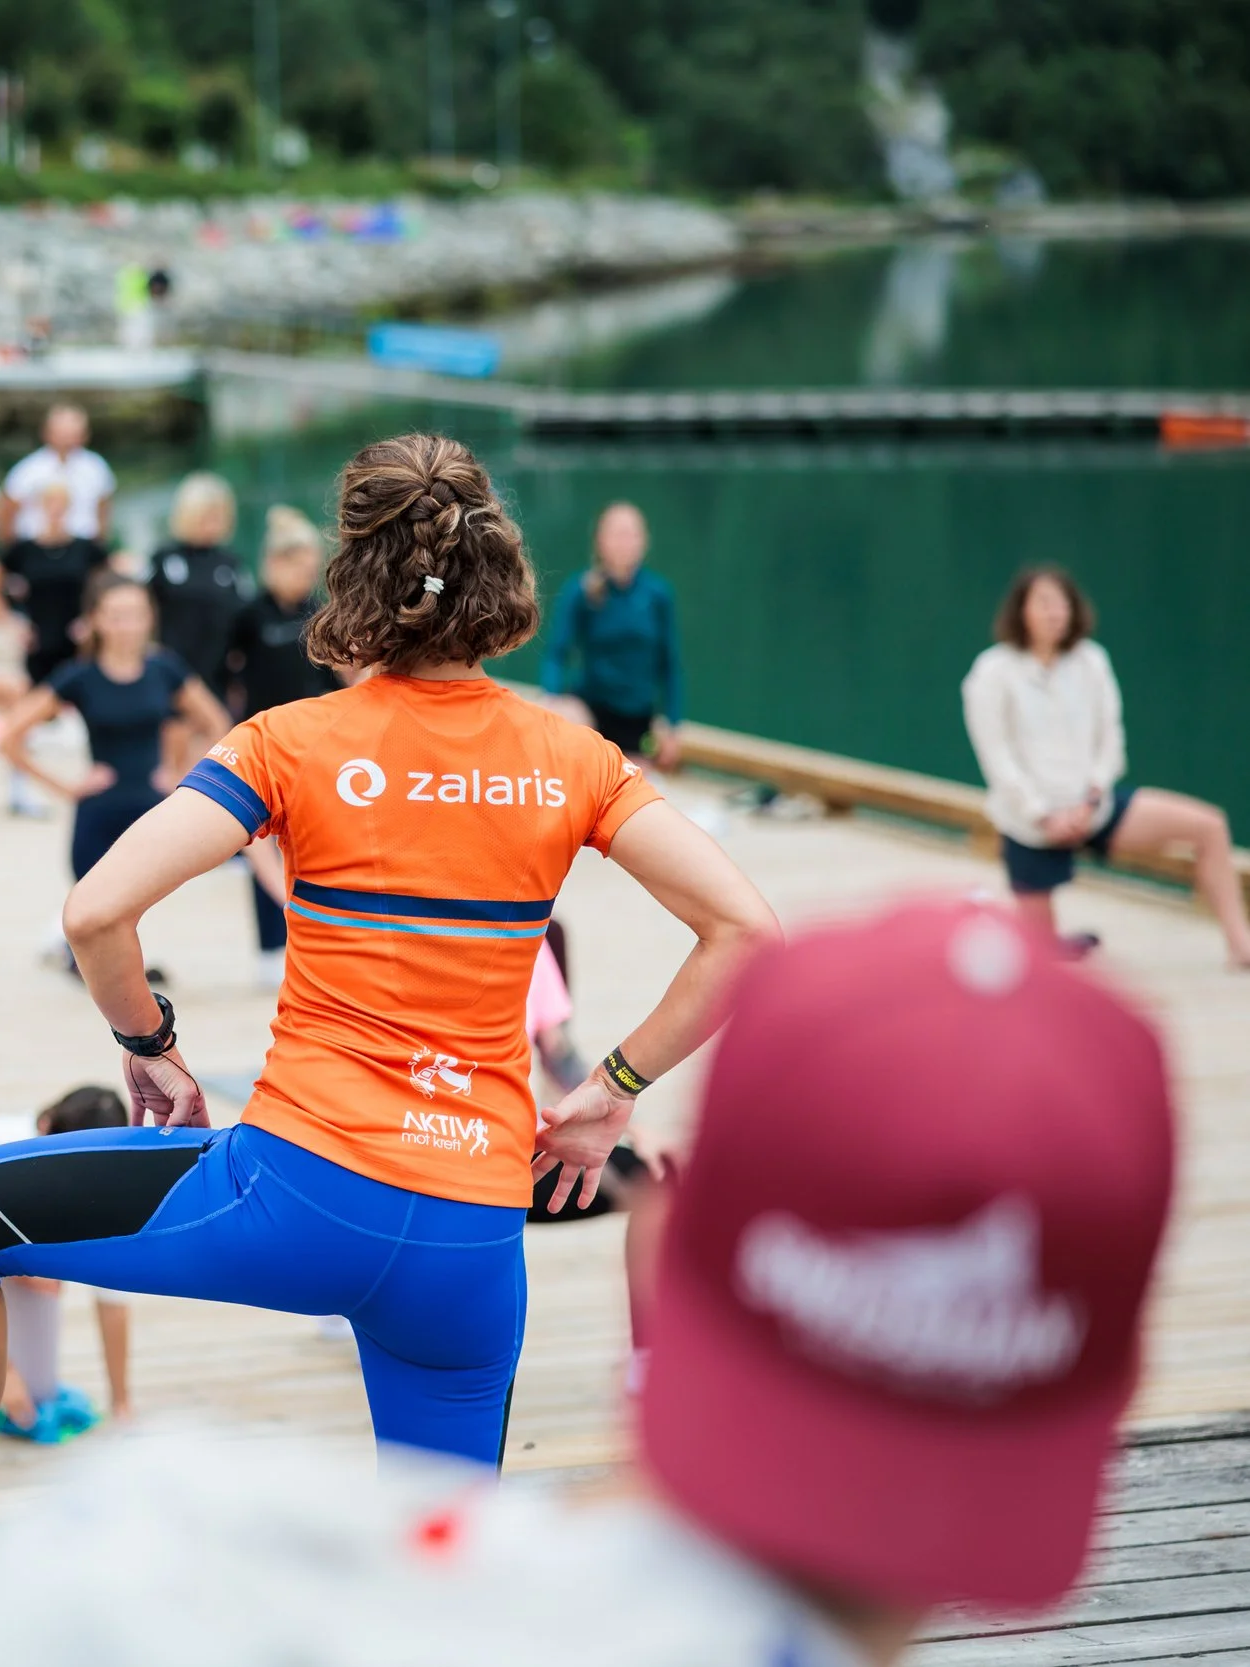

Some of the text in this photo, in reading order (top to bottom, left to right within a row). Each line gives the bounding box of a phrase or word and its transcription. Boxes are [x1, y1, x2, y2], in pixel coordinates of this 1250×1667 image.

[207, 744, 239, 766] aris
[406, 769, 567, 808] zalaris
[403, 1110, 476, 1140] AKTIV
[401, 1132, 462, 1152] mot kreft
